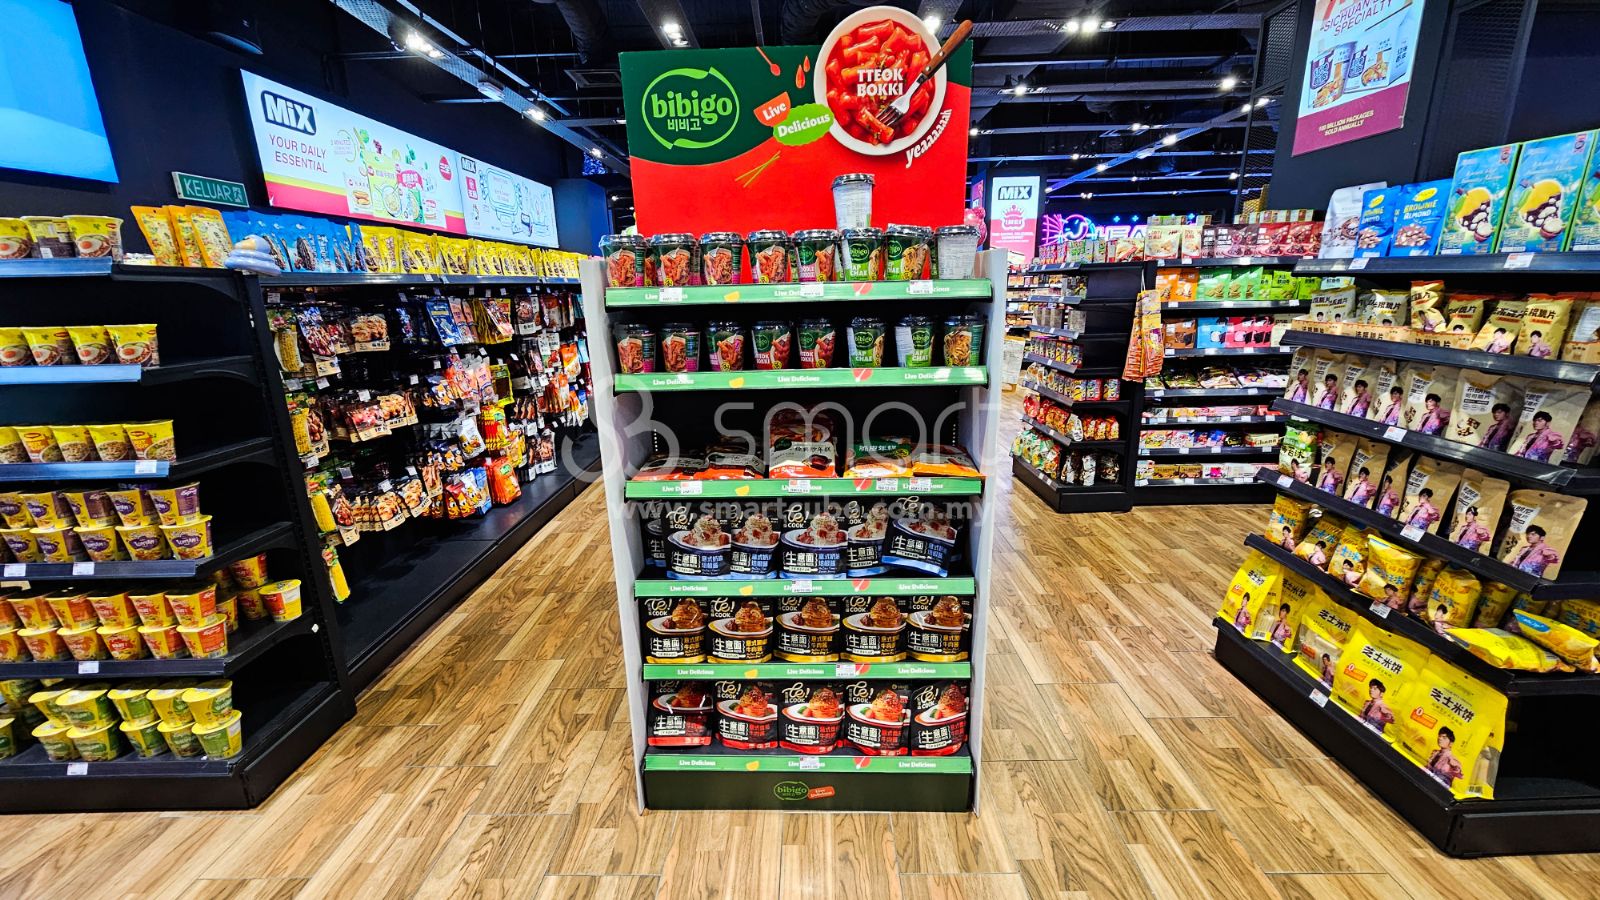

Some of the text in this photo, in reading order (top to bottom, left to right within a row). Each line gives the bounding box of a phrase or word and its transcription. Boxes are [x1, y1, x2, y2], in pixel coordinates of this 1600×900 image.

[857, 68, 903, 83] TTEOK
[857, 83, 903, 97] BOKKI
[652, 91, 733, 124] bibigo
[763, 102, 787, 121] Live
[668, 118, 702, 131] 비비고
[777, 113, 831, 138] Delicious
[269, 134, 298, 152] YOUR
[300, 142, 327, 158] DAILY
[275, 150, 328, 173] ESSENTIAL
[184, 178, 232, 201] KELUAR
[849, 634, 877, 648] 生意面
[910, 631, 939, 646] 生意面
[1361, 645, 1403, 674] 芝士米饼
[1430, 687, 1475, 722] 芝士米饼
[788, 724, 816, 739] 生意面
[850, 724, 877, 741] 生意面
[921, 727, 950, 744] 生意面
[777, 786, 807, 795] bibigo
